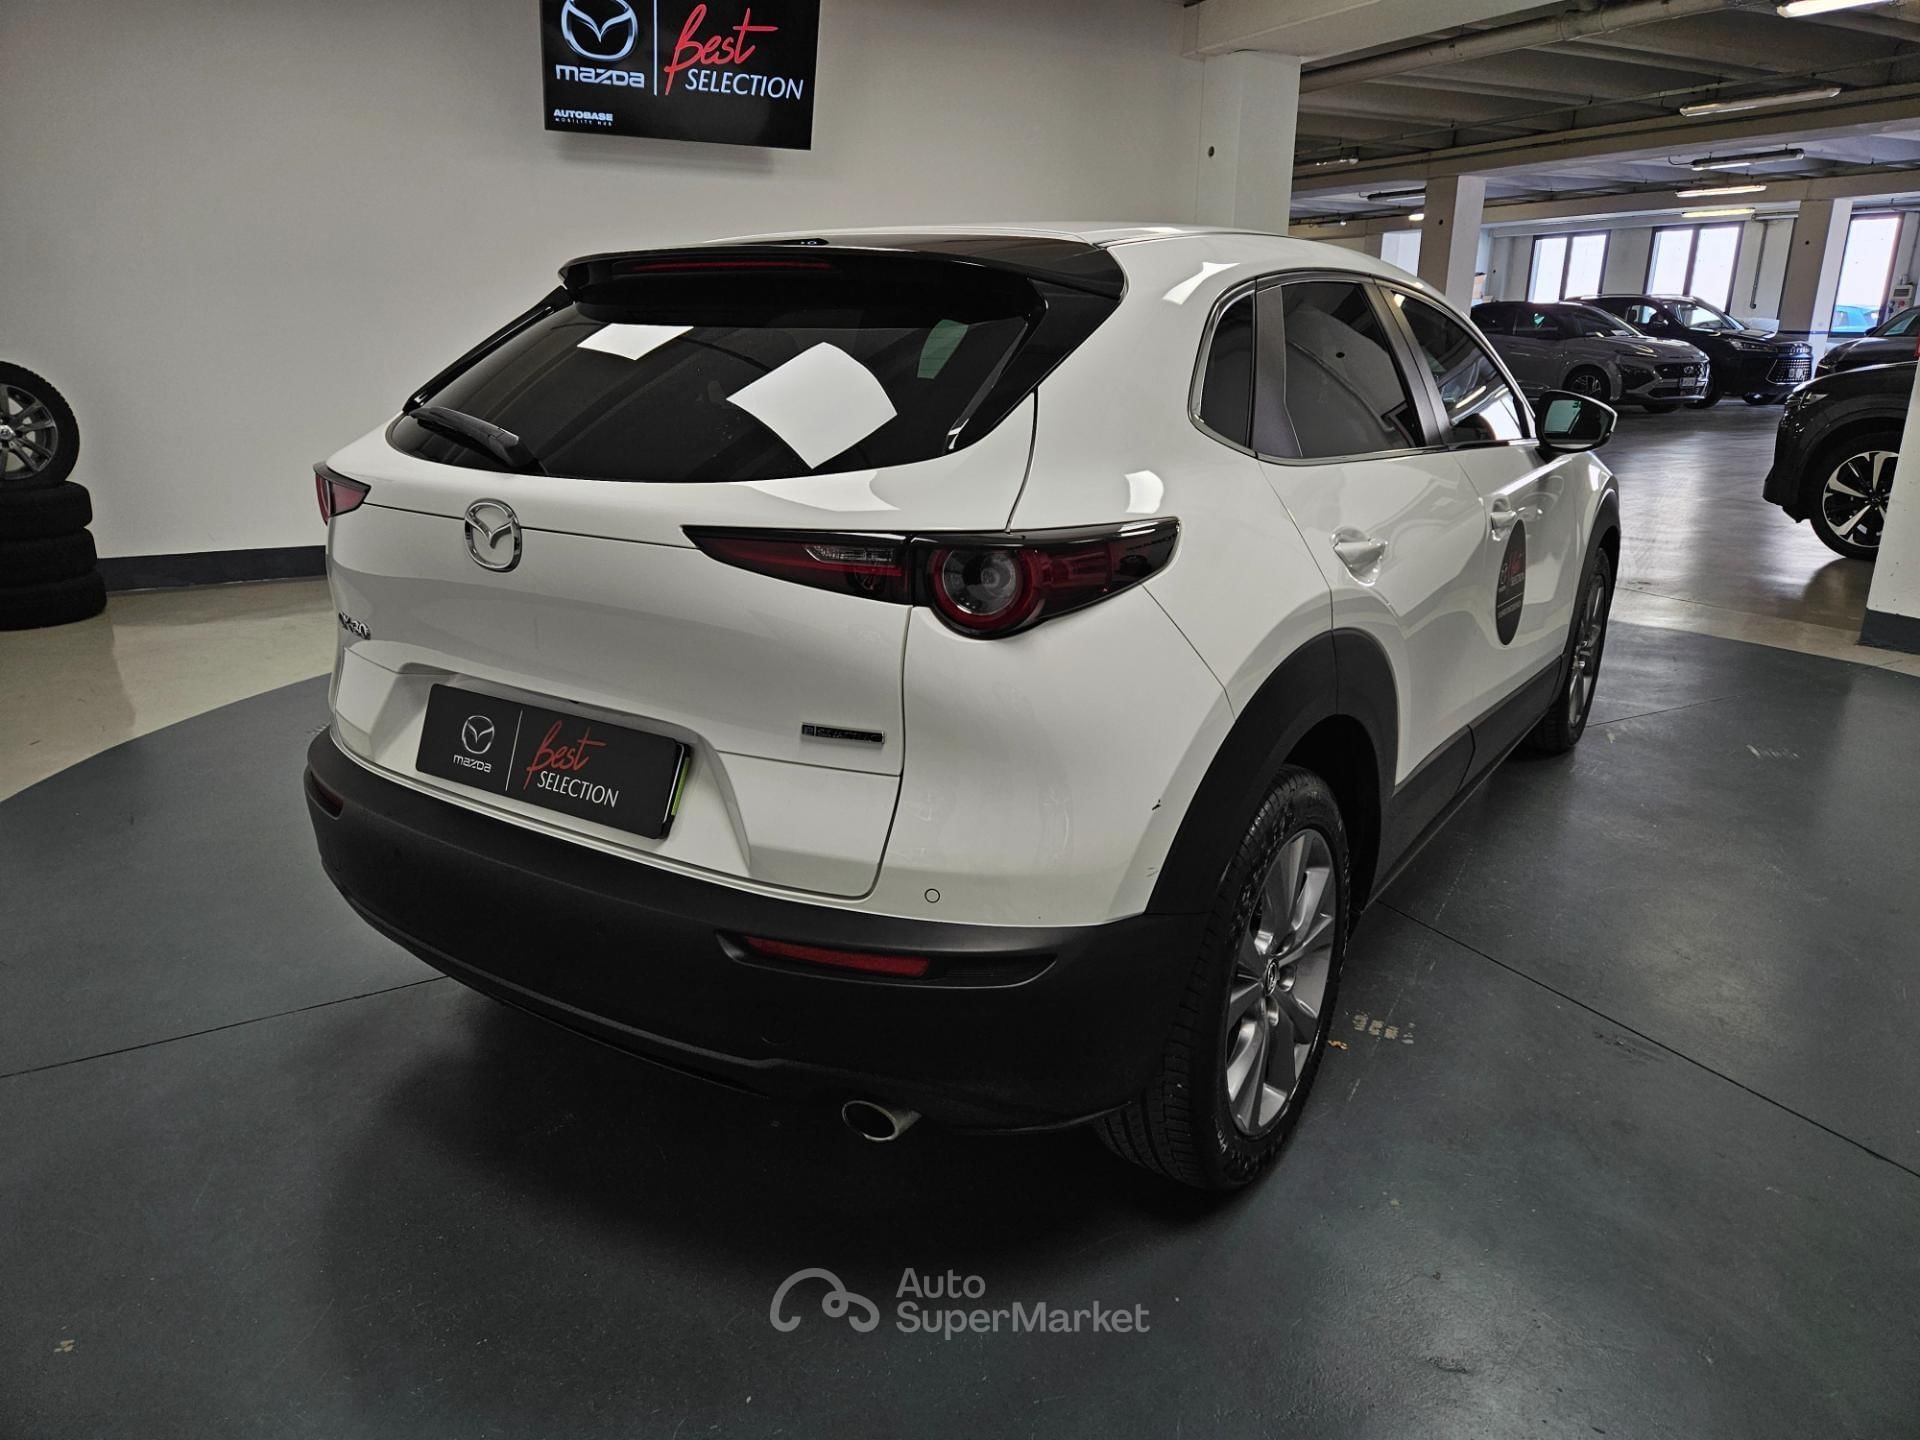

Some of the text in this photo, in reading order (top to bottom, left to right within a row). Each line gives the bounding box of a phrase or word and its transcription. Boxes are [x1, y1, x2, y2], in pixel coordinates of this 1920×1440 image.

[664, 4, 778, 95] Best
[685, 68, 804, 100] SELECTION
[554, 108, 613, 121] AUTOBASE
[523, 719, 607, 790] Best
[537, 770, 619, 808] SELECTION
